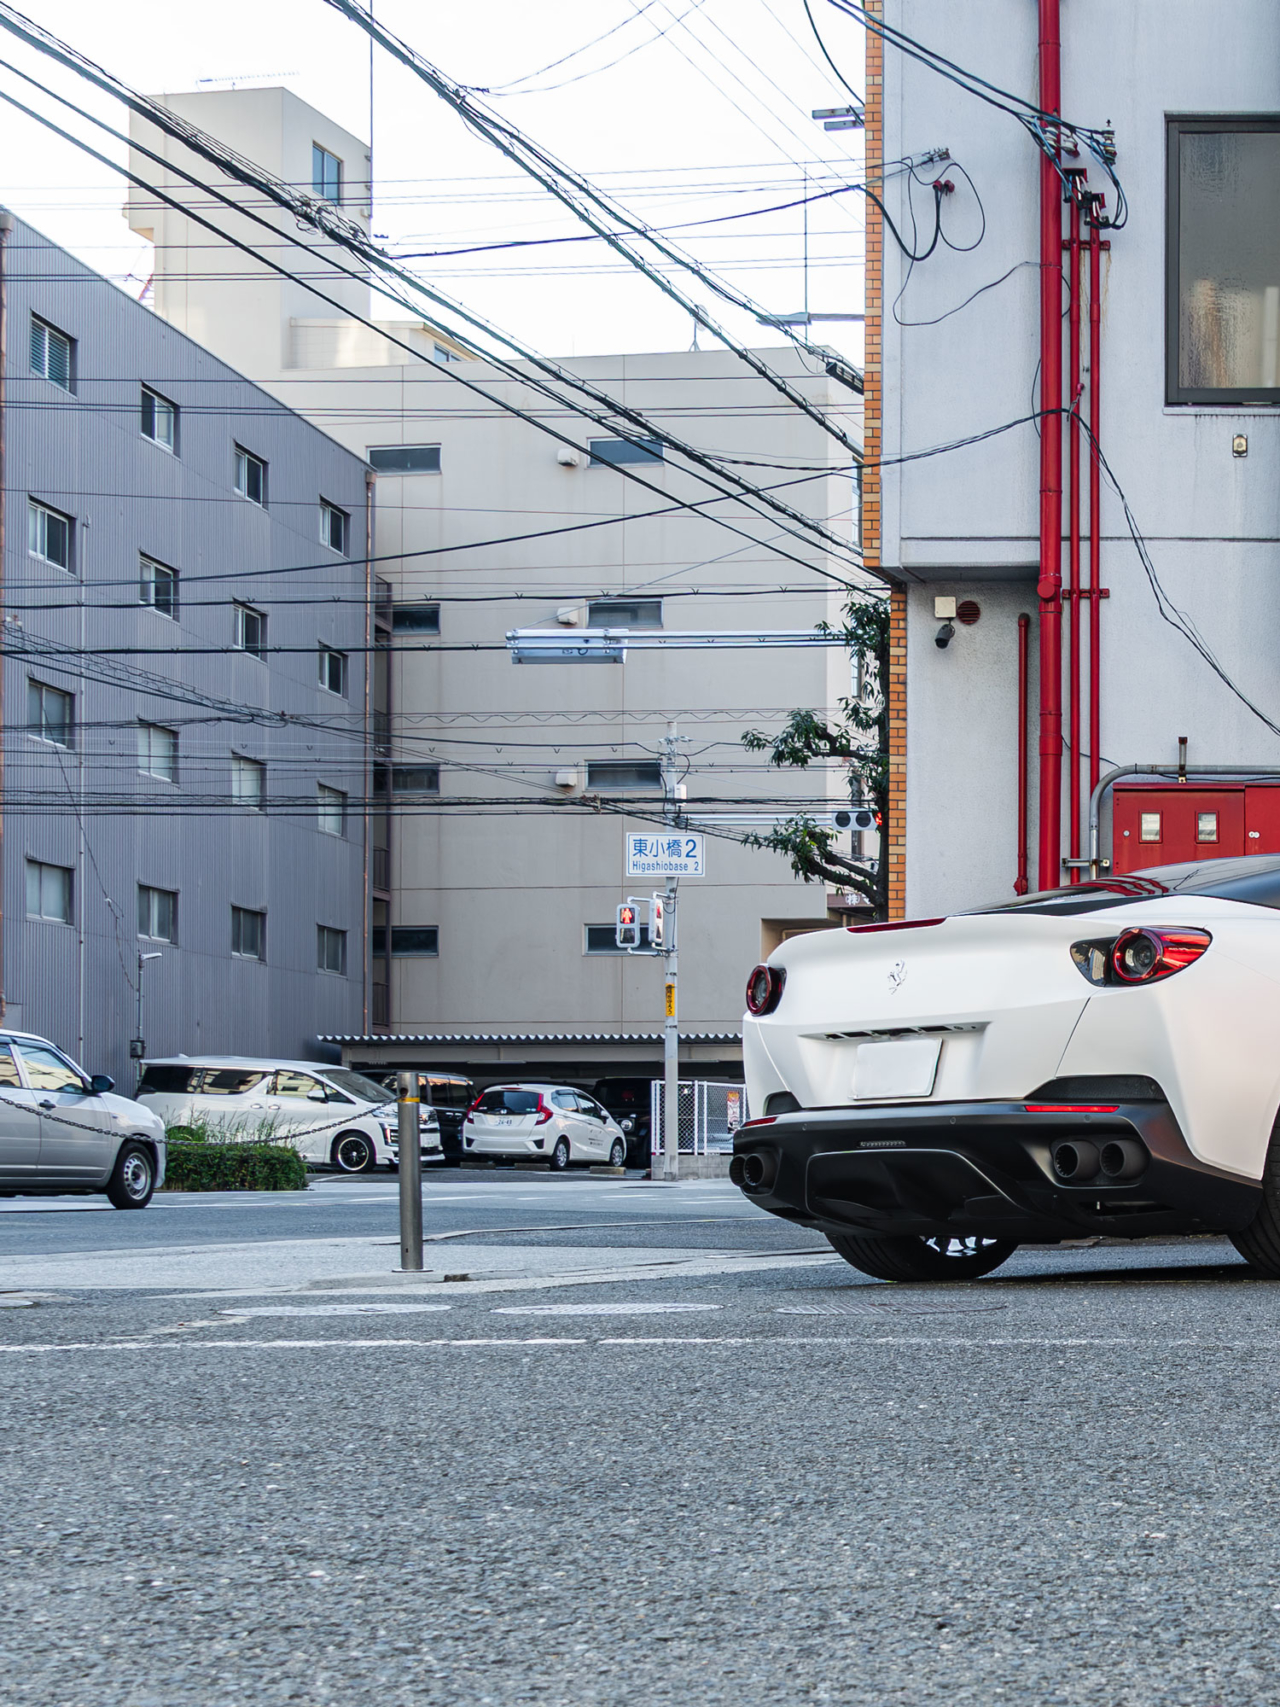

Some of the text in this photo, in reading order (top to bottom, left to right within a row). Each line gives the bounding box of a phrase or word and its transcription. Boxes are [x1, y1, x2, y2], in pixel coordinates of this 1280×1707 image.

[632, 838, 697, 858] 東小橋2
[632, 860, 699, 872] Higashiobase 2
